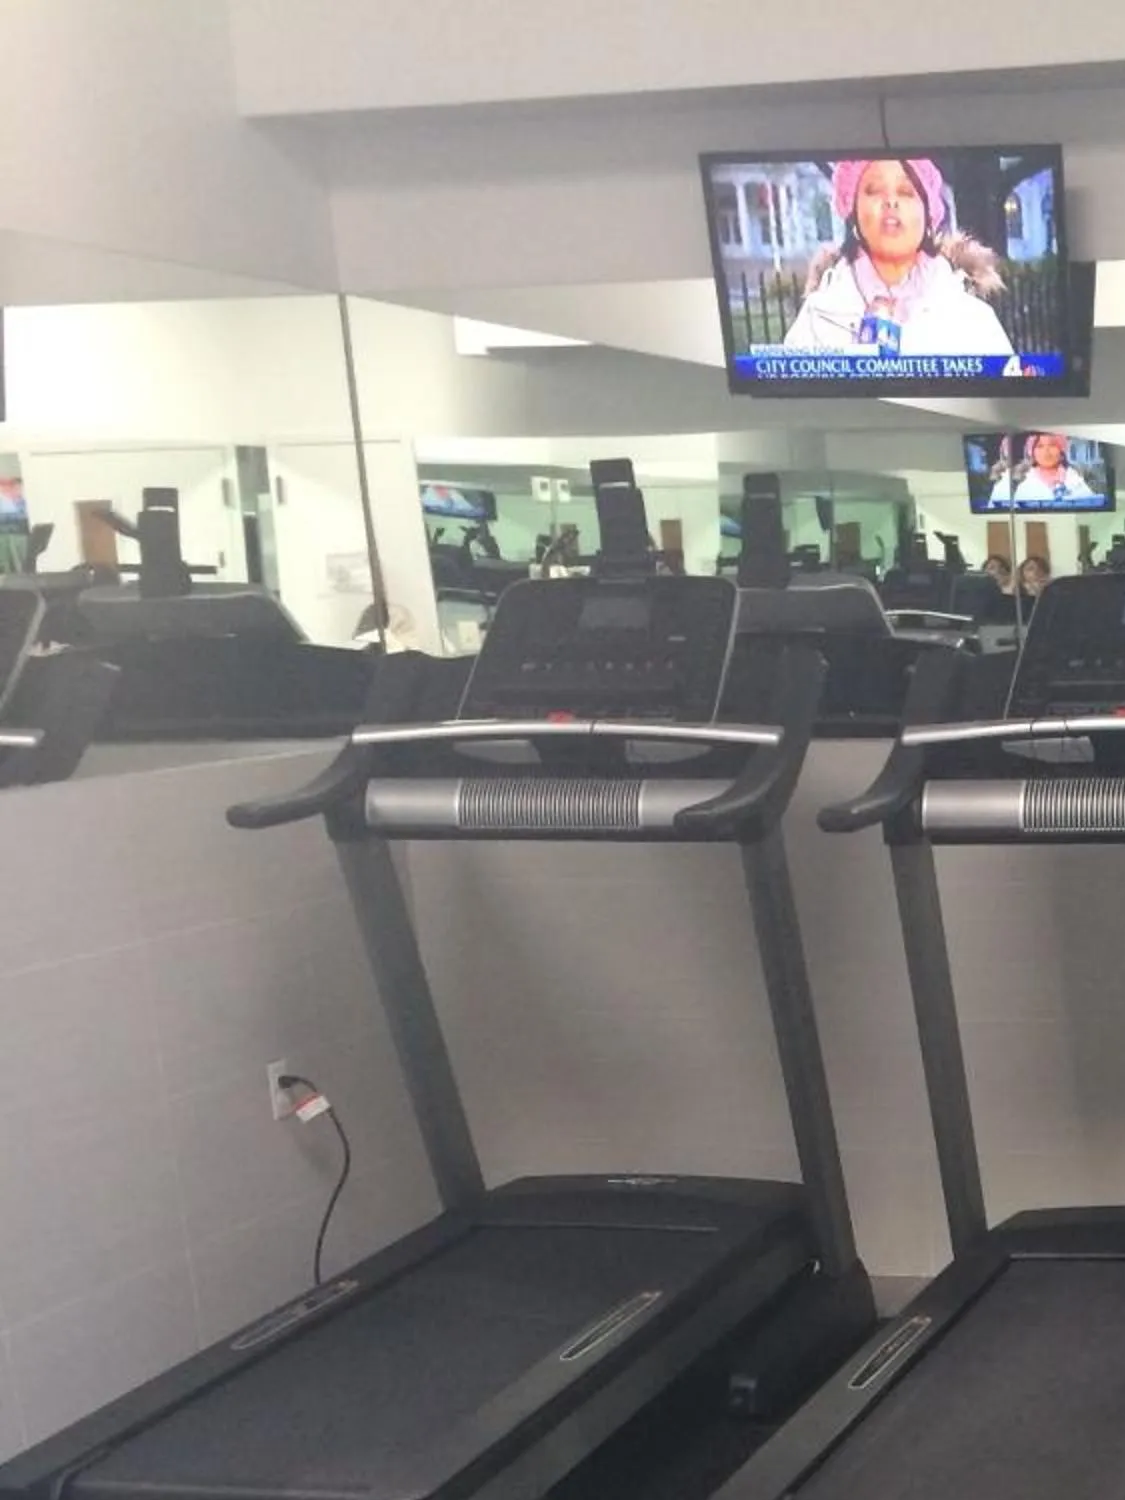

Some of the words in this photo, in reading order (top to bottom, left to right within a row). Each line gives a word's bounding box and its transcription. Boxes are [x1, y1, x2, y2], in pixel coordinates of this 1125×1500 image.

[756, 358, 787, 373] CITY
[790, 357, 851, 373] COUNCIL
[855, 357, 939, 373] COMMITTEE
[941, 356, 983, 373] TAKES
[1003, 354, 1023, 377] 4
